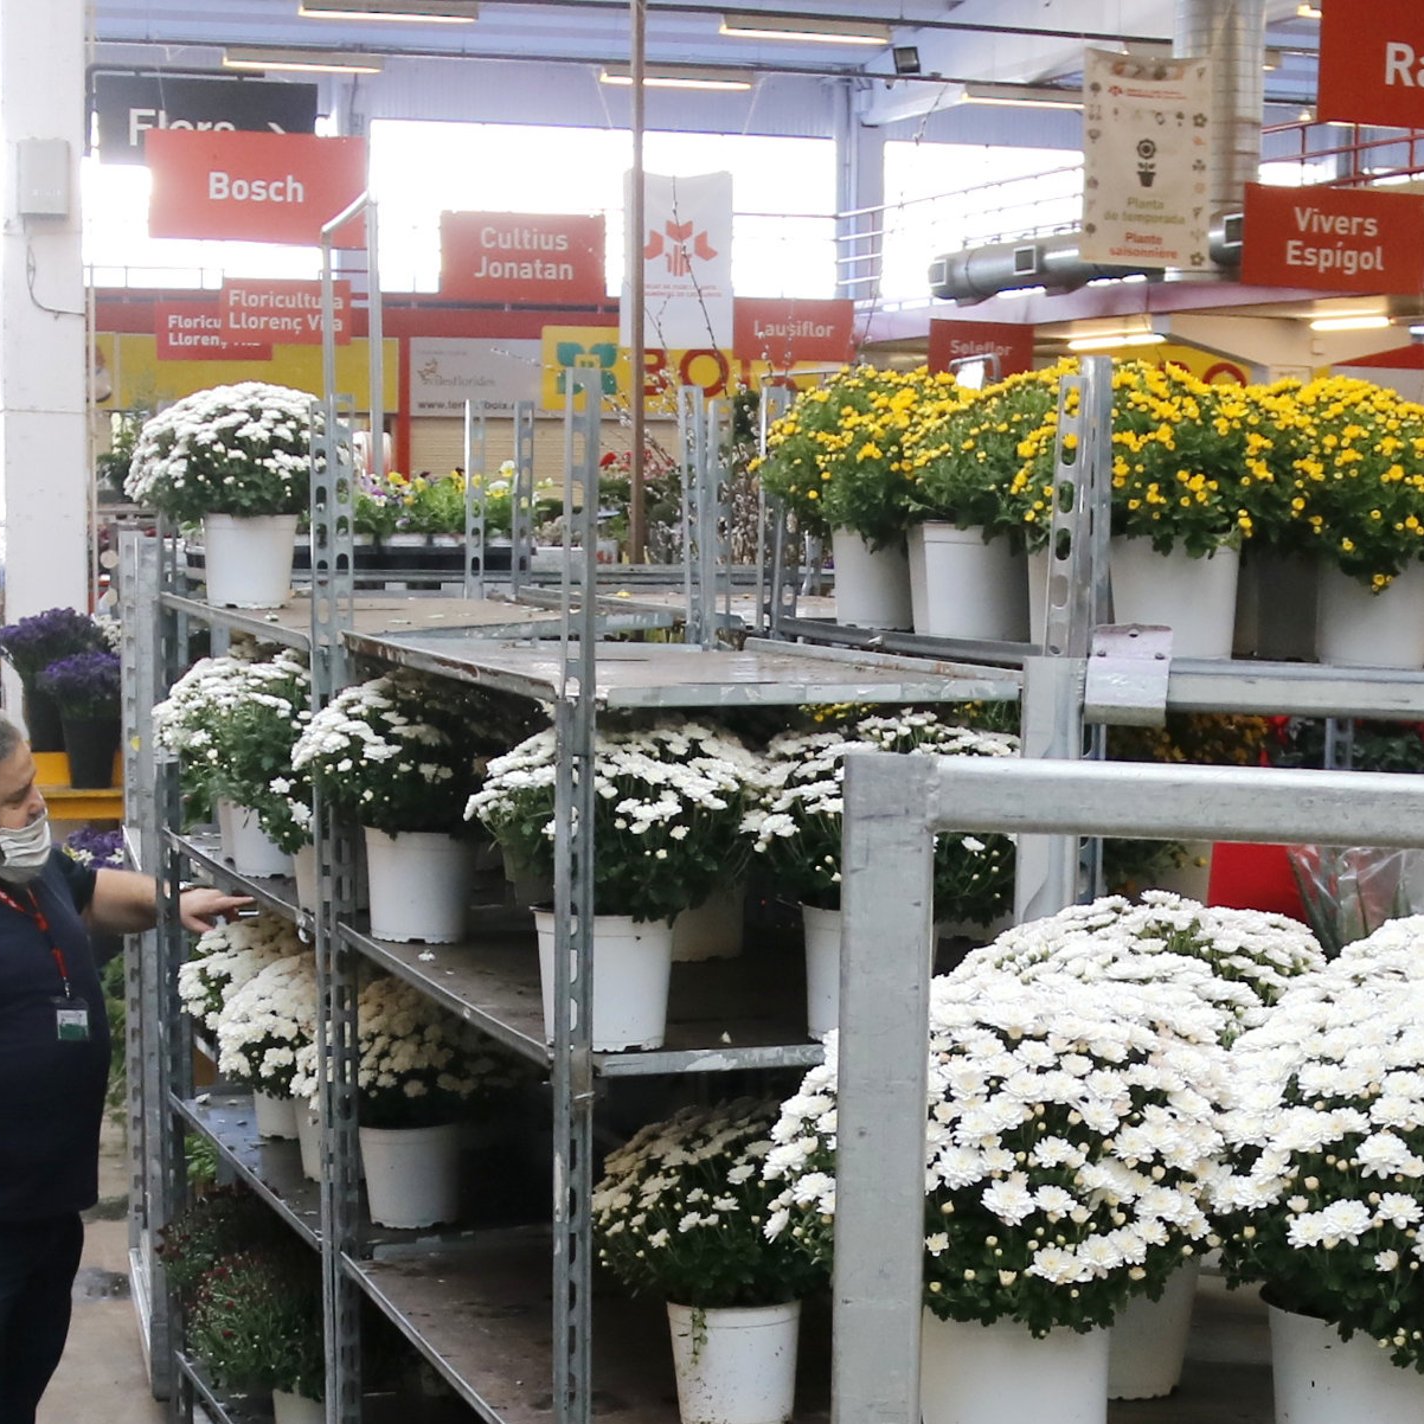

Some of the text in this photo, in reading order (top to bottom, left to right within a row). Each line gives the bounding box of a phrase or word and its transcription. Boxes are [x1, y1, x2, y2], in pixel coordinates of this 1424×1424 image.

[208, 171, 305, 203] Bosch
[1294, 206, 1379, 237] Vivers
[480, 226, 569, 251] Cultius
[474, 256, 574, 280] Jonatan
[1286, 240, 1385, 276] Espígol
[229, 289, 344, 309] Floricultua
[229, 312, 344, 335] Llorenç Via
[753, 320, 835, 338] Lausiflor
